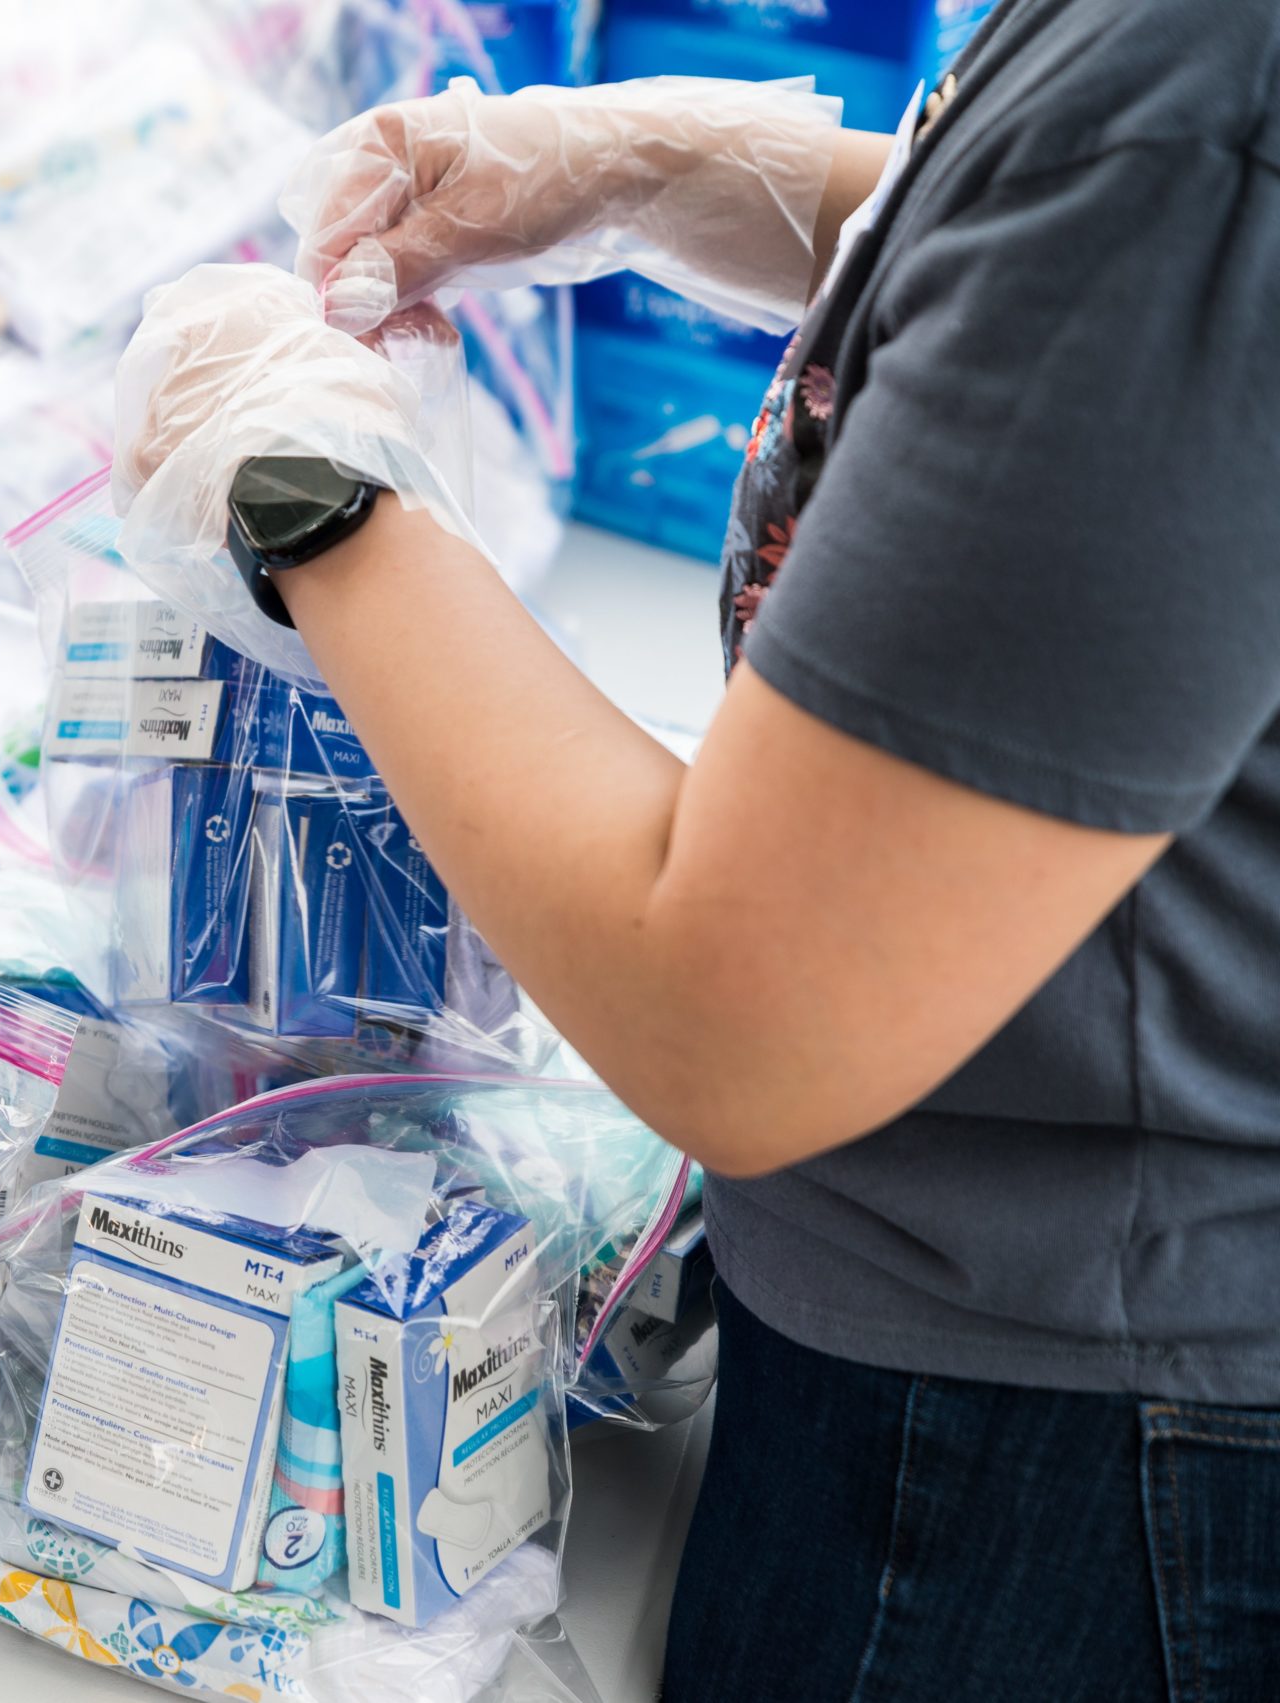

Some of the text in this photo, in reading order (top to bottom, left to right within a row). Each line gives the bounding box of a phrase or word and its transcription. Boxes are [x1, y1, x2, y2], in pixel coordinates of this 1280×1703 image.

[138, 637, 184, 661] Maxithins
[158, 688, 182, 702] MAXI
[137, 717, 192, 743] Maxithins
[333, 751, 360, 764] MAXI
[89, 1206, 185, 1260] Maxithins
[243, 1258, 286, 1285] MT-4
[505, 1244, 528, 1271] MT-4
[245, 1283, 281, 1305] MAXI
[650, 1272, 663, 1299] MT-4
[106, 1287, 147, 1308] Protection
[152, 1303, 207, 1329] Multi-Channel
[208, 1323, 237, 1341] Design
[353, 1327, 378, 1344] MT-4
[63, 1336, 207, 1396] Protección normal diseño multicanal
[452, 1334, 532, 1404] Maxithins
[344, 1374, 358, 1418] MAXI
[369, 1354, 393, 1453] Maxithins
[476, 1384, 514, 1426] MAXI
[51, 1397, 91, 1418] Protection
[91, 1412, 126, 1433] régulière
[502, 1419, 529, 1441] NORMAL
[463, 1455, 502, 1485] PROTECTION
[283, 1534, 305, 1560] 2
[471, 1560, 485, 1575] PAD
[488, 1537, 512, 1561] TOALLA
[515, 1509, 545, 1538] SERVIETTE
[368, 1544, 378, 1584] NORMAL
[383, 1534, 394, 1592] PROTECTION
